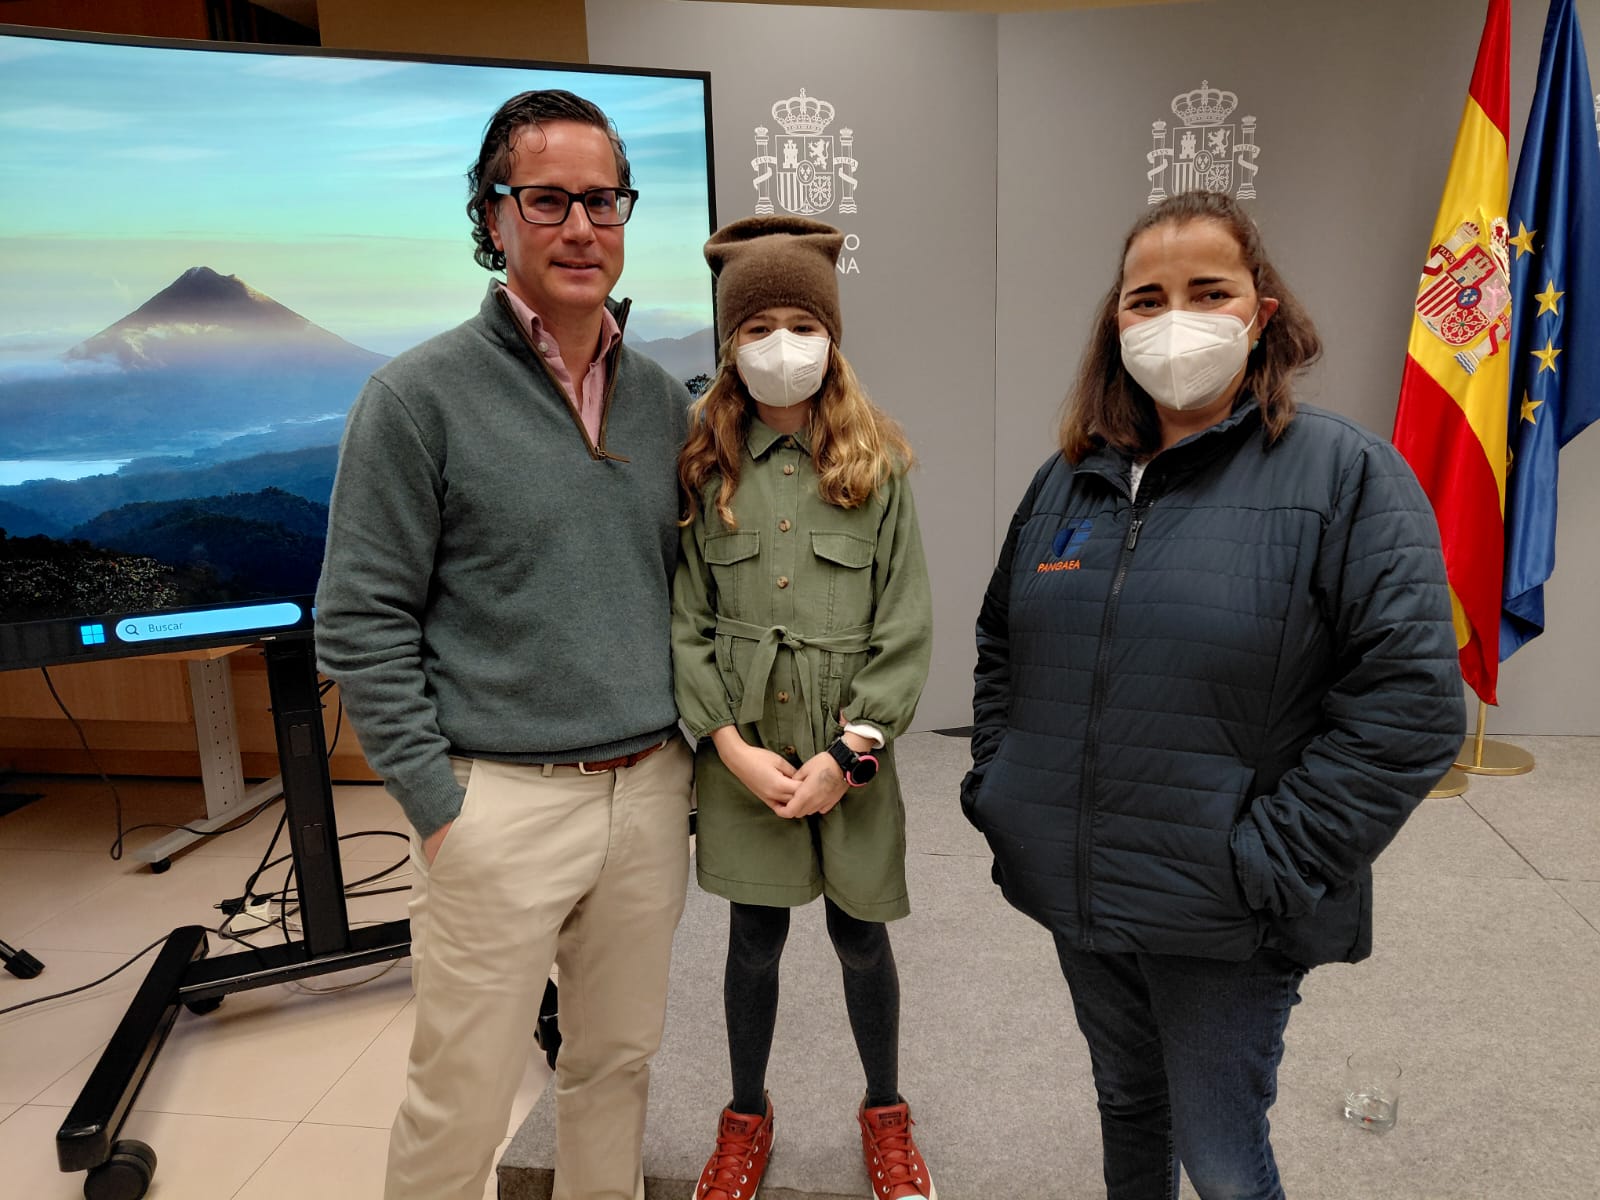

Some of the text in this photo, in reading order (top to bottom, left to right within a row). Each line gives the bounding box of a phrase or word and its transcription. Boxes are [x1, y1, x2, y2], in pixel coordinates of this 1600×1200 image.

[1439, 246, 1456, 263] PLVS
[1037, 560, 1080, 573] PANGAEA
[148, 622, 184, 632] Buscar
